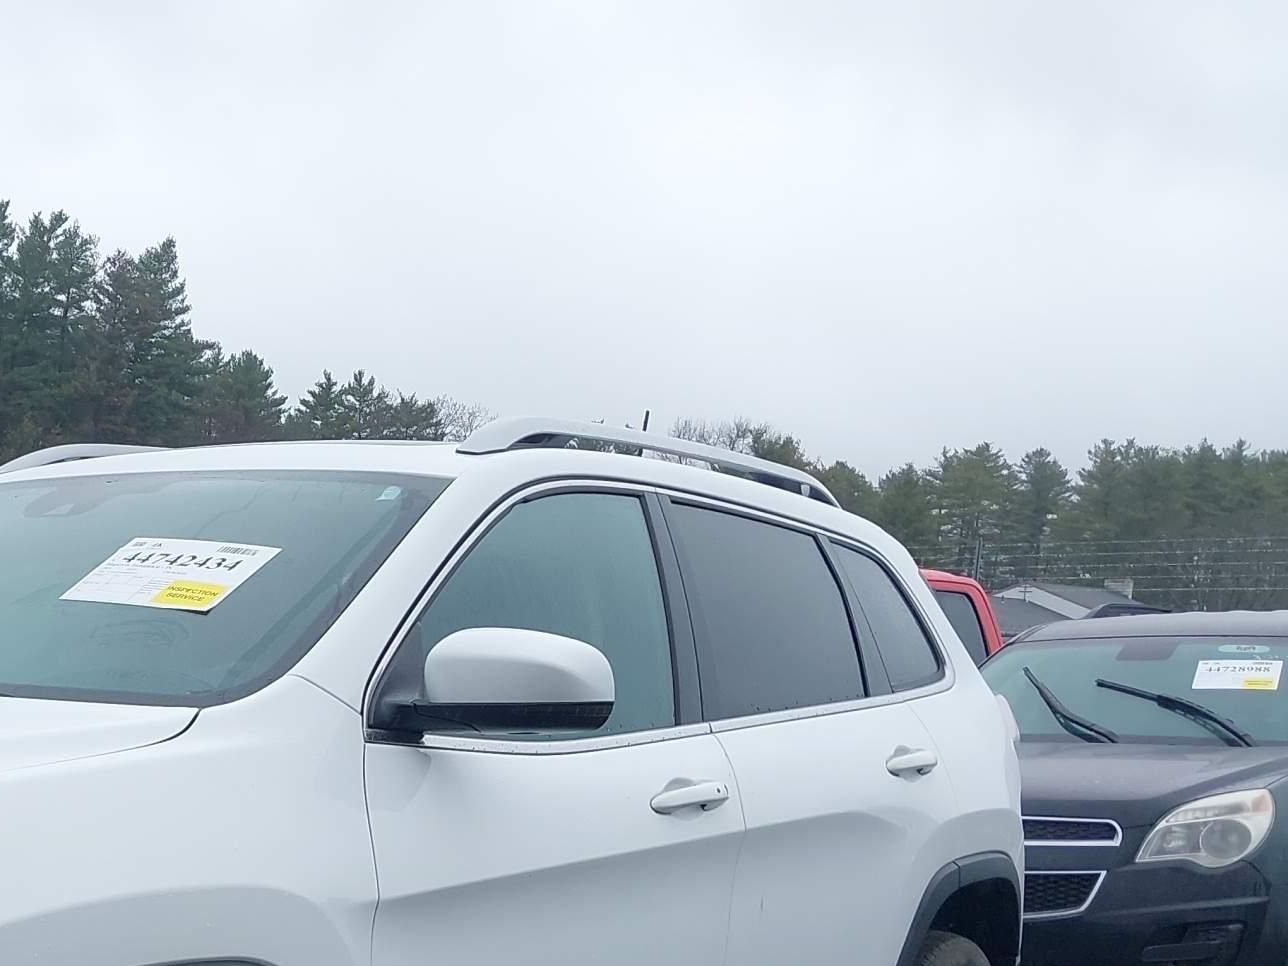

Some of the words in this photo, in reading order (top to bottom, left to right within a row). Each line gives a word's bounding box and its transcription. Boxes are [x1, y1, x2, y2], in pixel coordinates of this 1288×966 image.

[123, 551, 244, 571] 44742434
[165, 592, 205, 602] SERVICE
[166, 585, 219, 598] INSPECTION
